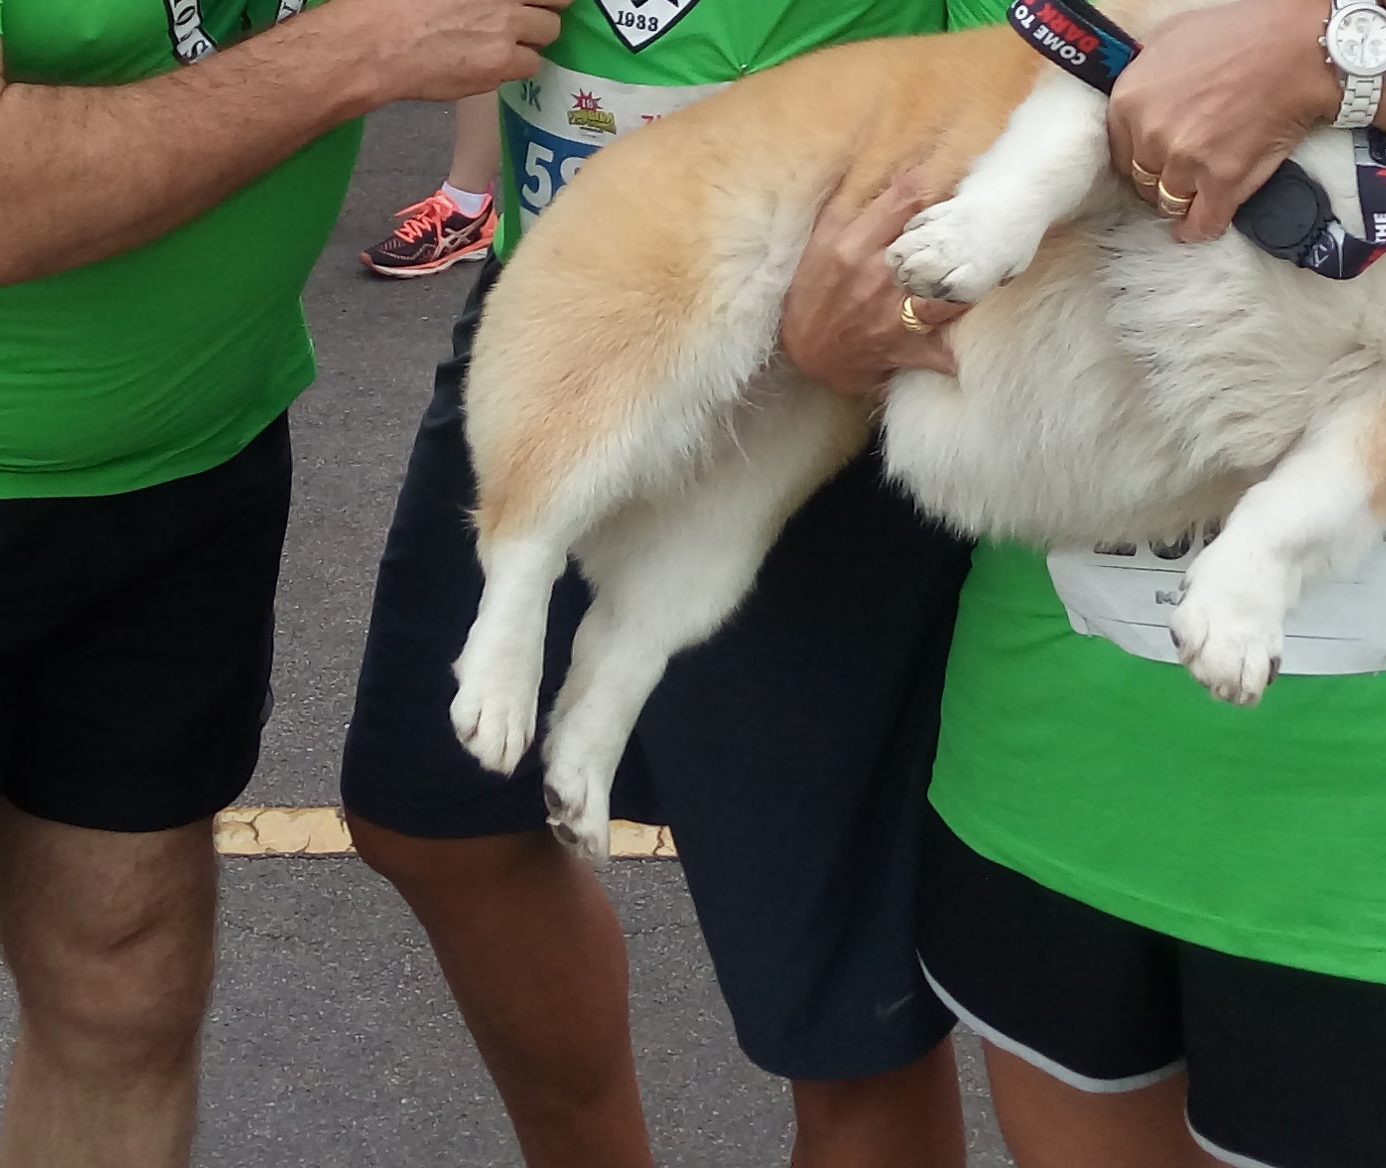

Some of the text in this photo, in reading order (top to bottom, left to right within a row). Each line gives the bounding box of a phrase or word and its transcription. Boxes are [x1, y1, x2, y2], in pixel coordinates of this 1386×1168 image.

[615, 10, 660, 33] 1933
[1014, 4, 1088, 66] COME TO
[1035, 2, 1101, 54] DARK
